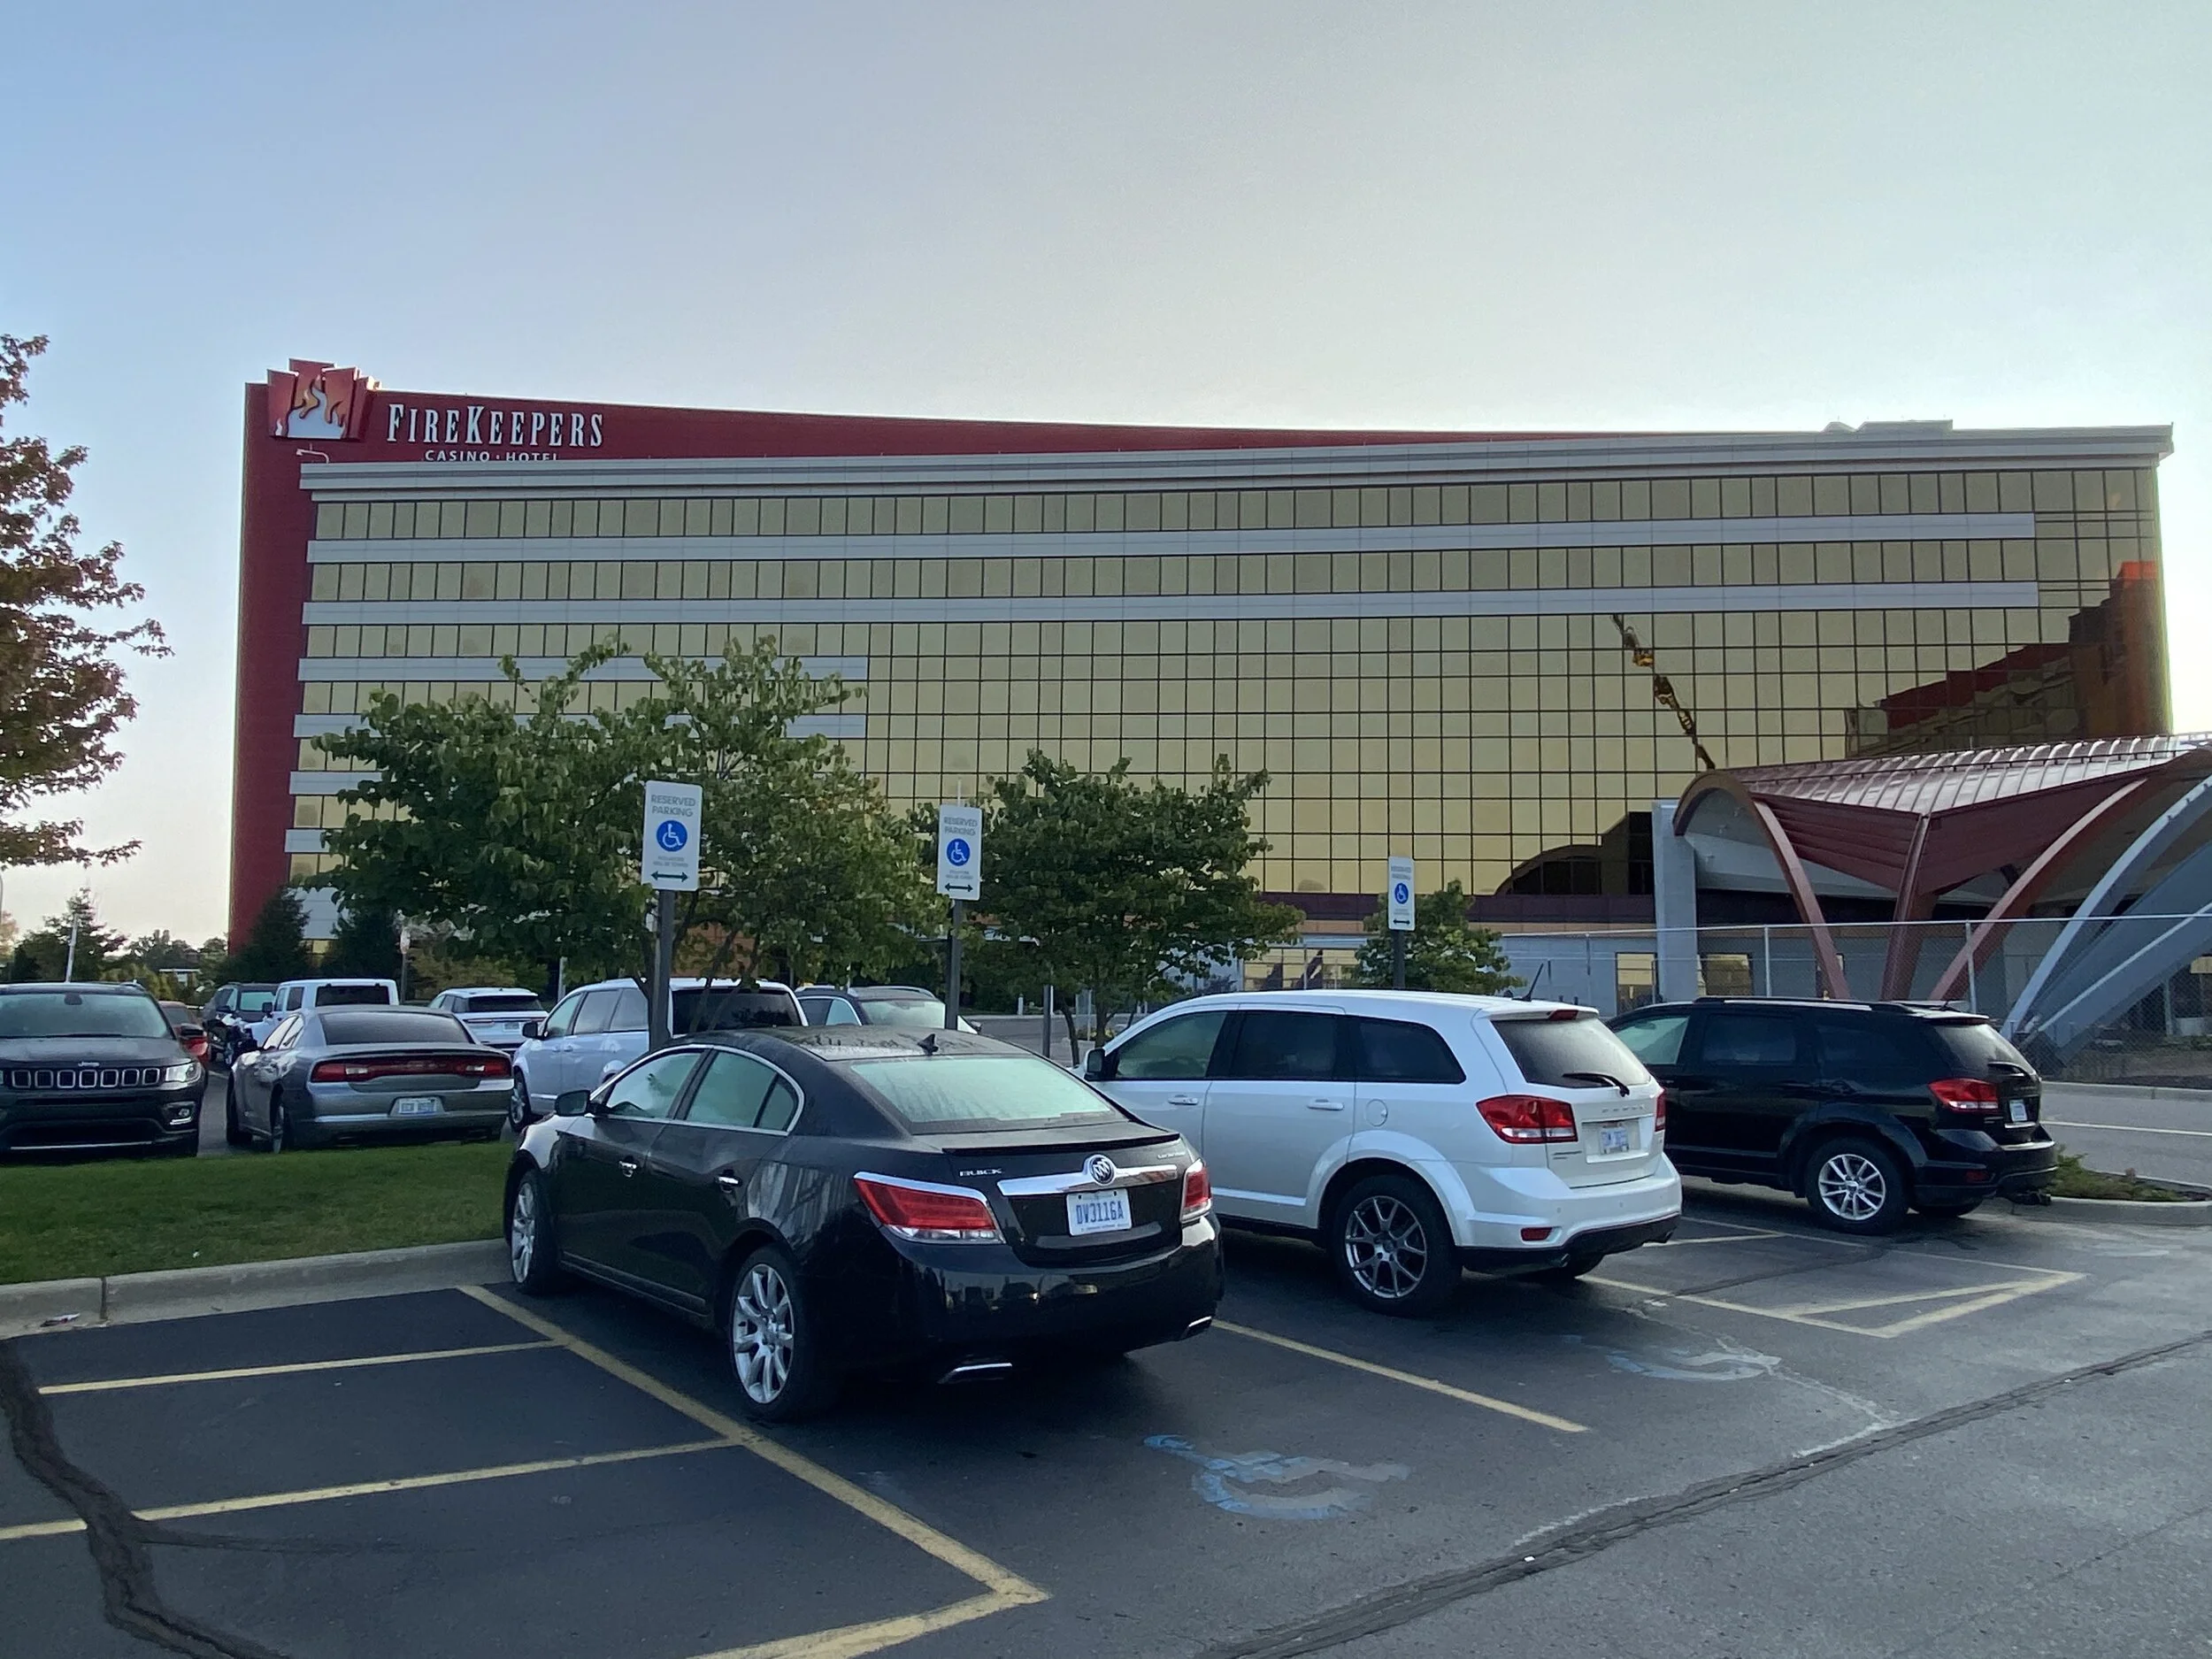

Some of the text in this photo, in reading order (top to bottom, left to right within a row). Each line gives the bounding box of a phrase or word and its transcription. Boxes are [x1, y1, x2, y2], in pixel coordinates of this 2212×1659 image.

[386, 403, 603, 448] FIREKEEPERS
[425, 449, 490, 462] CASINO
[650, 795, 696, 807] RESERVED
[651, 806, 694, 818] PARKING
[1076, 1201, 1125, 1225] DV3116A
